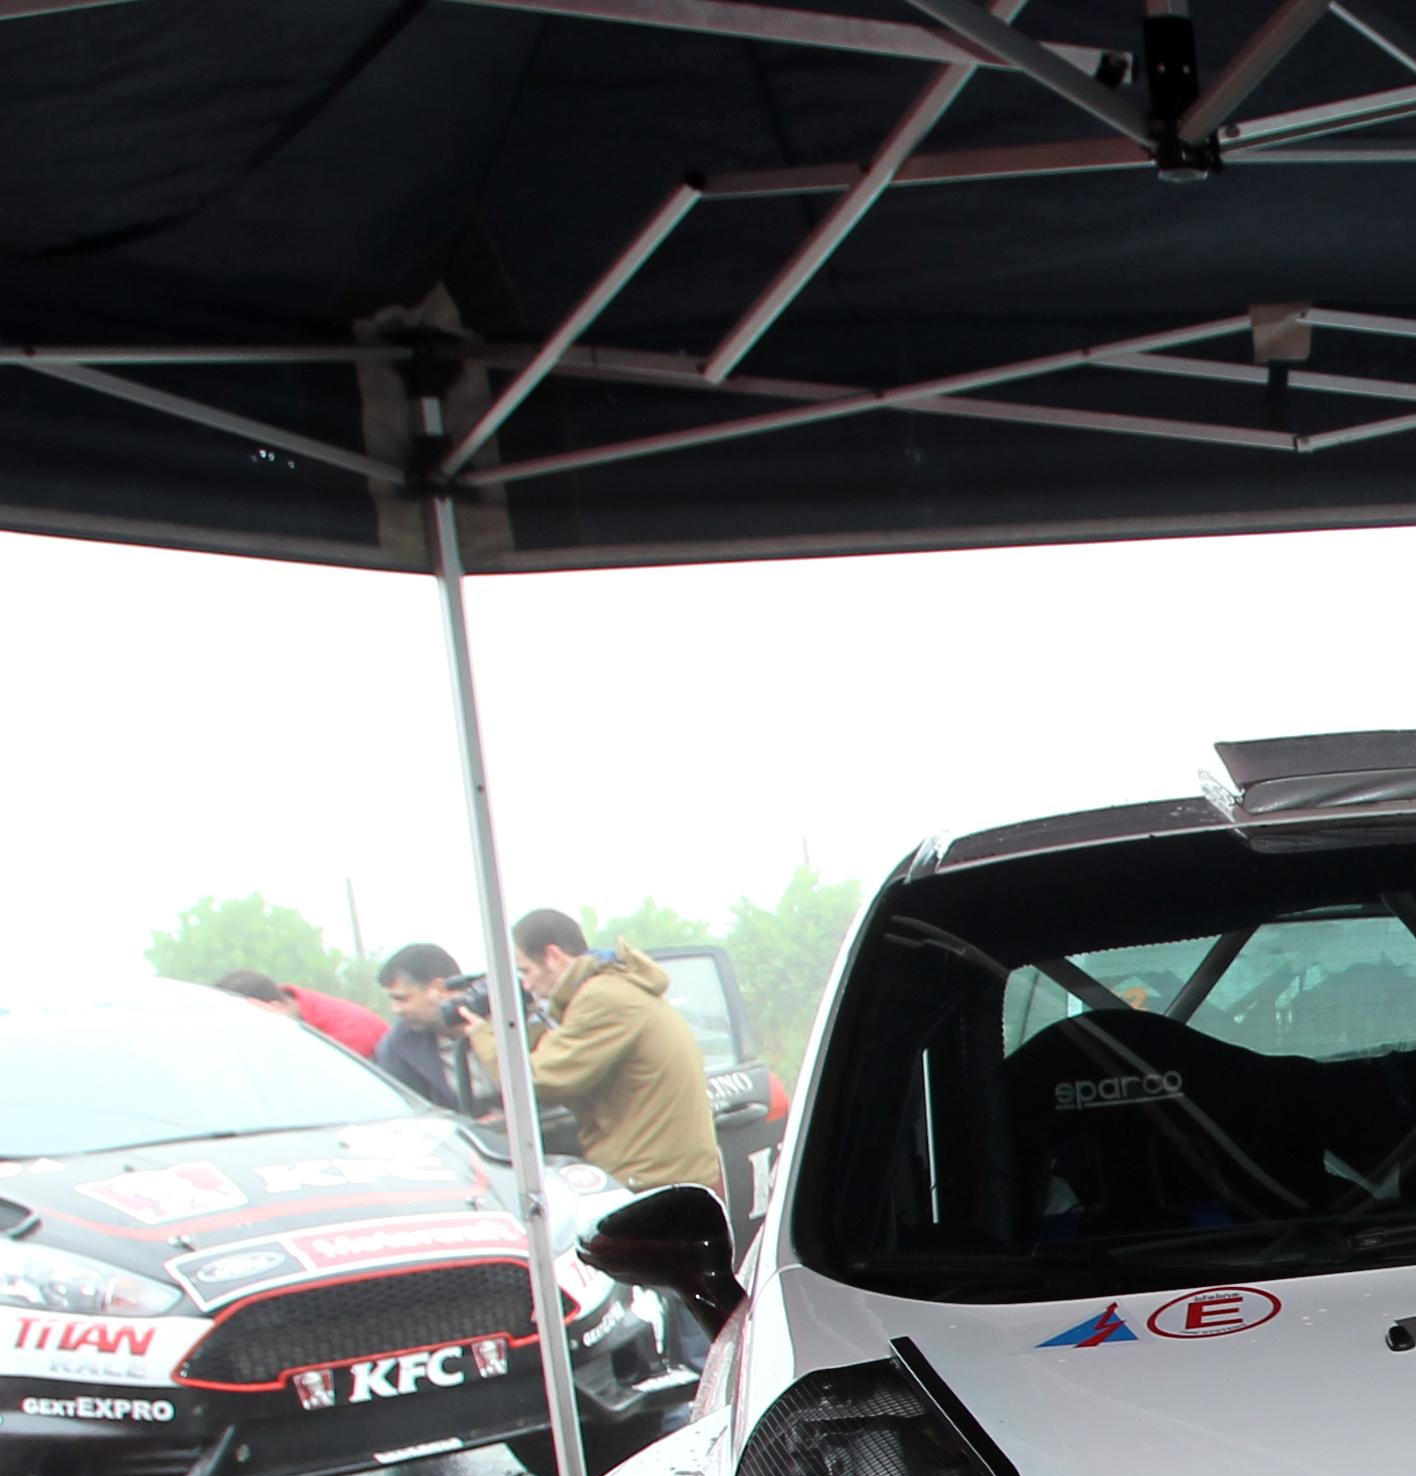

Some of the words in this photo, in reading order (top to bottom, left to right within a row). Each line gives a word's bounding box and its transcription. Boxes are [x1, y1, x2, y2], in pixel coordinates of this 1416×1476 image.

[1055, 1071, 1183, 1109] sparco
[1186, 1297, 1244, 1329] E
[349, 1346, 465, 1403] KFC
